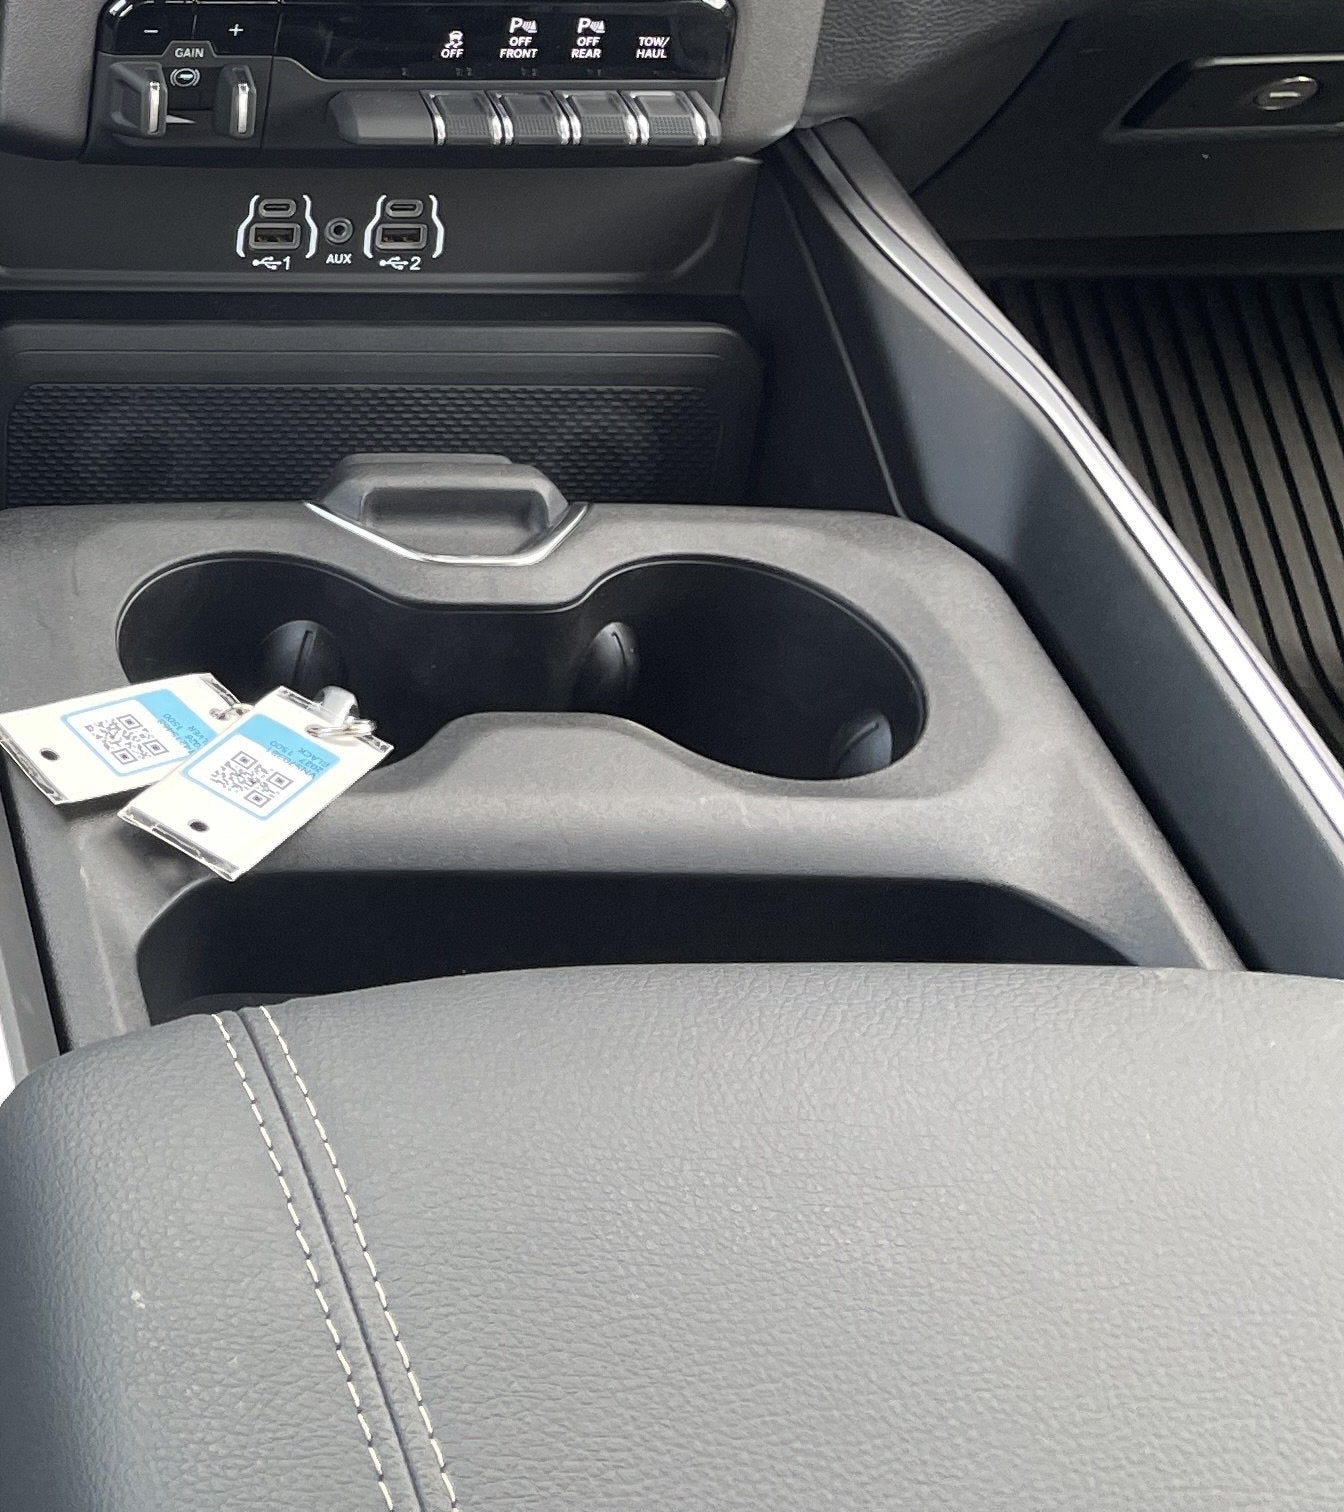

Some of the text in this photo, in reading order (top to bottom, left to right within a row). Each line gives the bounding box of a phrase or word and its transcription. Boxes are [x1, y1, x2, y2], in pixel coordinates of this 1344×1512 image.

[509, 36, 532, 47] OFF
[576, 36, 600, 47] OFF
[638, 36, 671, 48] TOW/
[174, 47, 204, 58] GAIN
[440, 48, 463, 59] OFF
[500, 48, 538, 59] FRONT
[571, 48, 601, 59] REAR
[636, 48, 667, 59] HAUL
[282, 256, 291, 270] 1
[325, 253, 352, 264] AUX
[410, 256, 421, 271] 2
